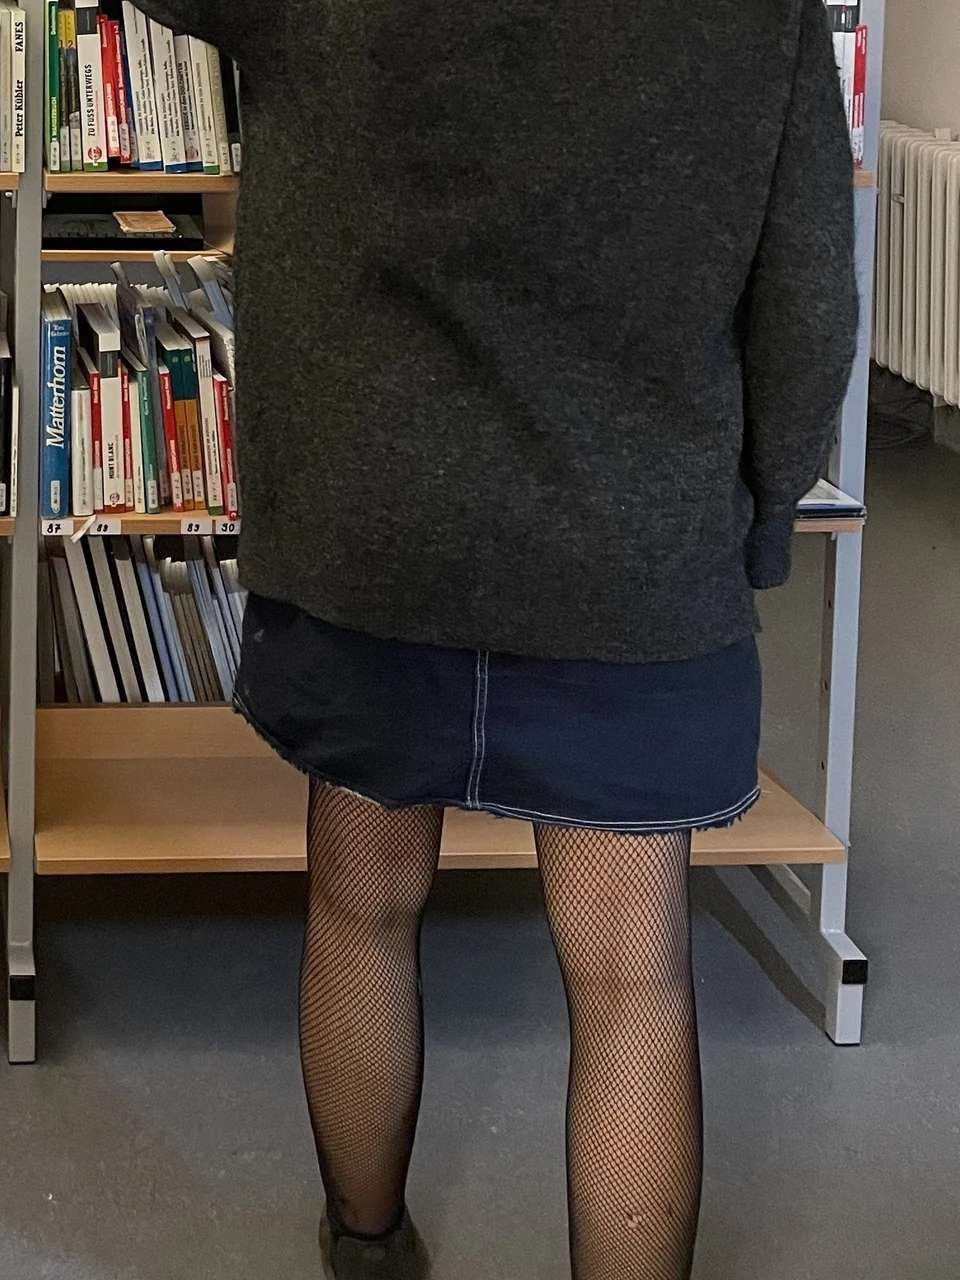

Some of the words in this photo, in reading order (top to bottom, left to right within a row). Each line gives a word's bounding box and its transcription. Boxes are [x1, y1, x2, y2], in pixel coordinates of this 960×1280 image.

[15, 21, 23, 52] FANES
[15, 79, 24, 111] Kübler
[85, 64, 94, 107] UNTERWEGS
[15, 114, 24, 137] Peter
[87, 108, 95, 126] FUSS
[88, 127, 96, 137] ZU
[45, 345, 66, 449] Matterhorn
[47, 524, 62, 533] 87
